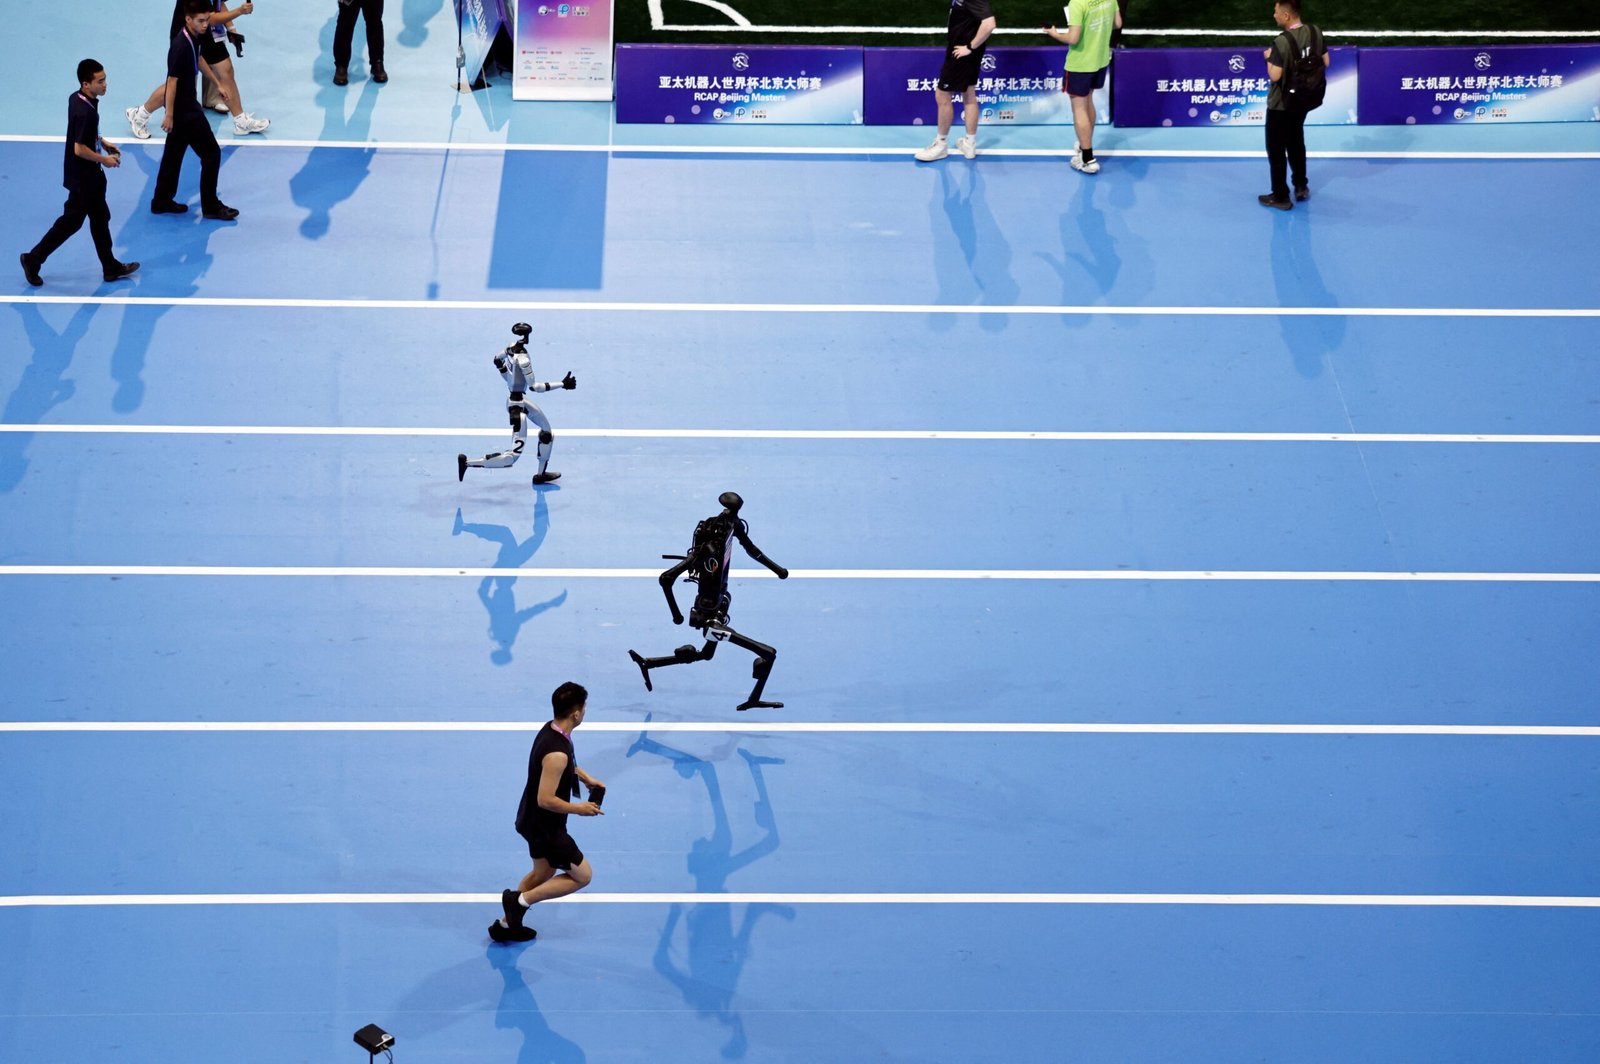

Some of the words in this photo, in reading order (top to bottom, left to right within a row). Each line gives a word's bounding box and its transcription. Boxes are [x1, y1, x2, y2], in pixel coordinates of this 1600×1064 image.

[659, 76, 822, 91] 亚太机器人世界杯北京大师赛
[1156, 78, 1270, 92] 亚太机器人世界杯北
[1401, 75, 1562, 90] 亚太机器人世界杯北京大师赛
[694, 92, 719, 102] RCAP
[720, 92, 750, 103] Beijing
[751, 92, 786, 102] Masters
[998, 94, 1033, 103] Masters
[1191, 95, 1216, 104] RCAP
[1217, 95, 1246, 105] Beijing
[1247, 95, 1268, 104] Mast
[1435, 92, 1460, 102] RCAP
[1461, 92, 1491, 103] Beijing
[1492, 92, 1527, 101] Masters
[513, 440, 525, 454] 2
[711, 631, 728, 641] 4
